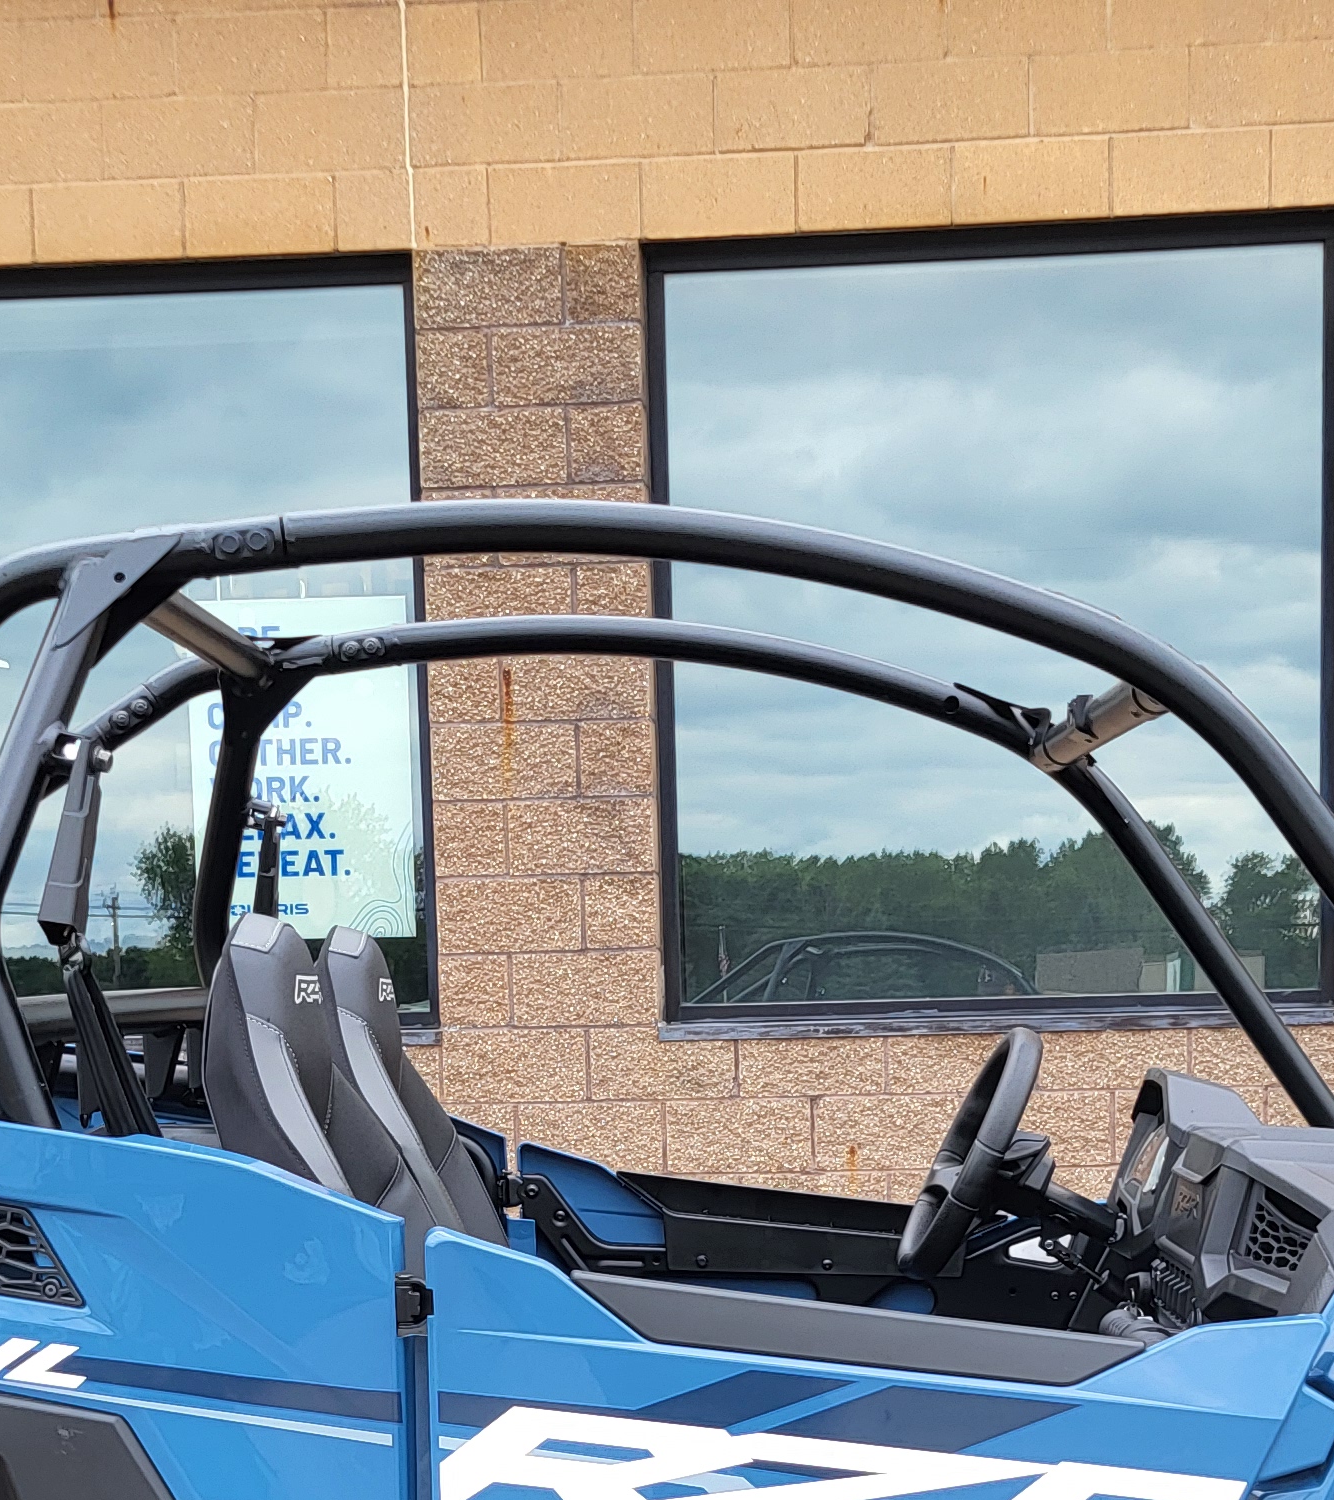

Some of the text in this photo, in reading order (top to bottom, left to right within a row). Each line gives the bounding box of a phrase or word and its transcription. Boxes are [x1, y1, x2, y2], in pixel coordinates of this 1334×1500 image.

[207, 701, 312, 731] CP.
[210, 776, 320, 803] ORK.
[237, 849, 351, 878] EEAT.
